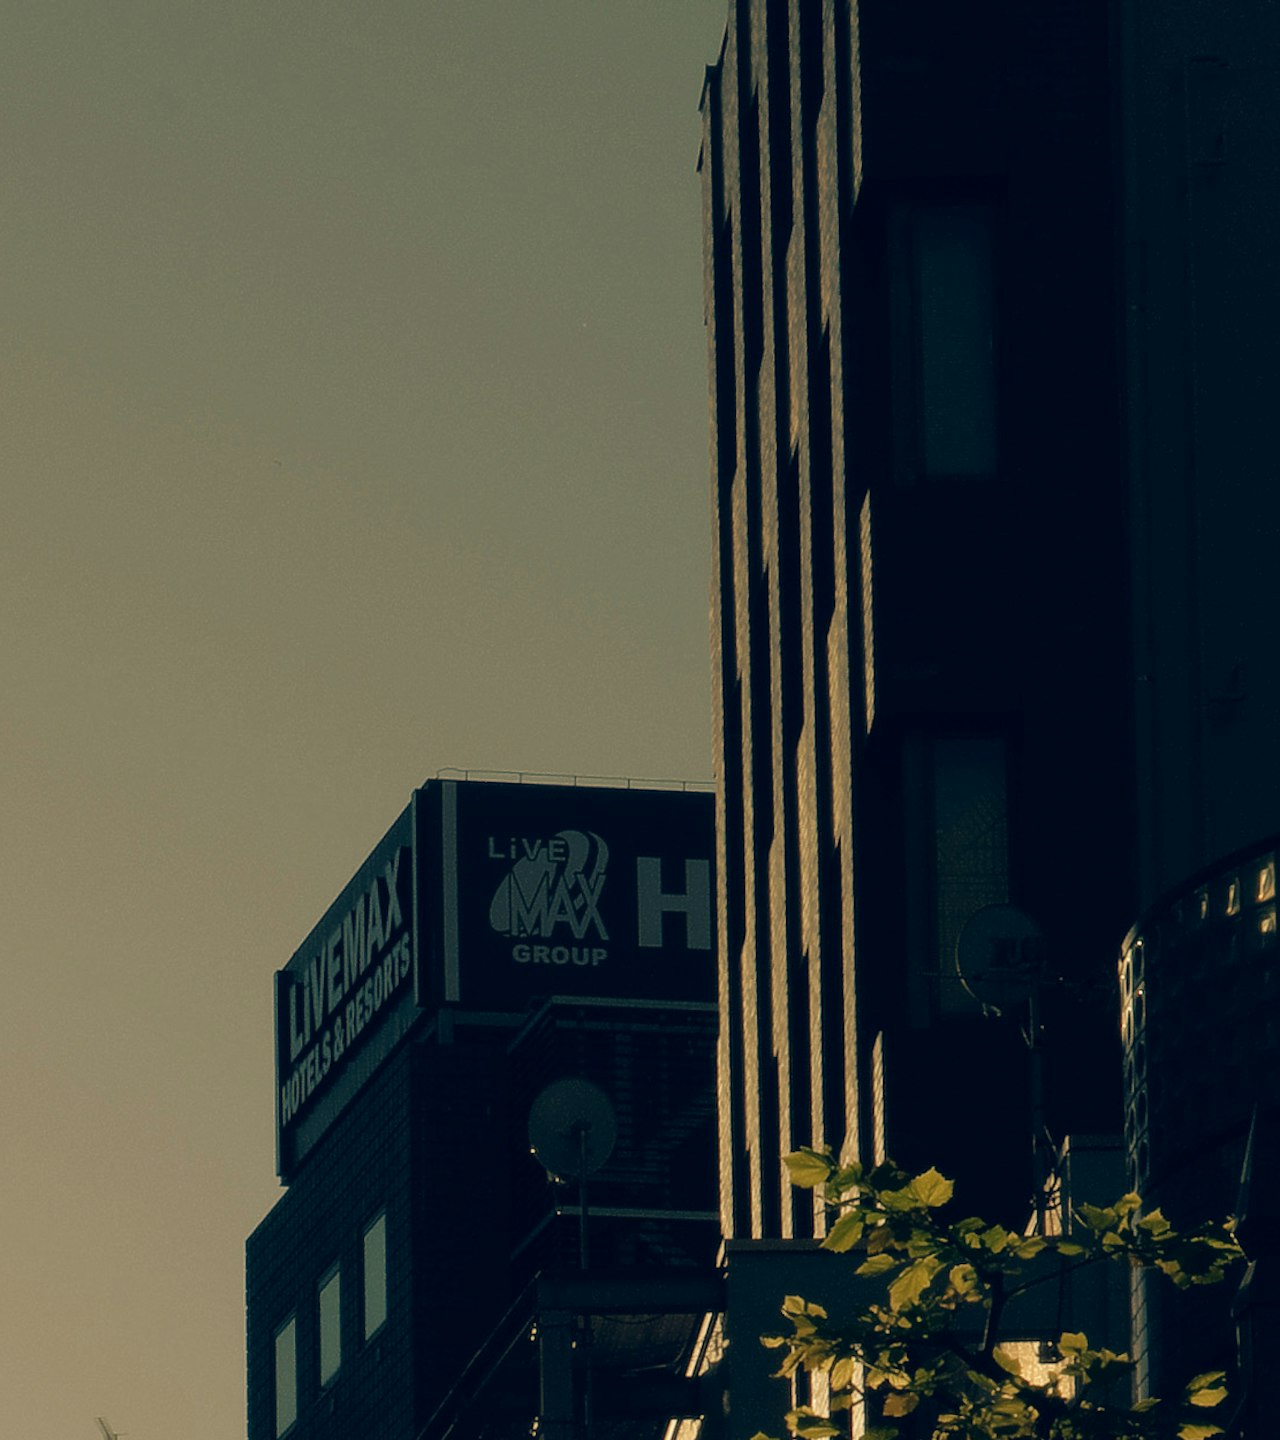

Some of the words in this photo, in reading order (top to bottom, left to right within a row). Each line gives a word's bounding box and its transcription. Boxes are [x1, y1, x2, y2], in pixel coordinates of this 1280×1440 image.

[510, 872, 610, 941] MAX
[512, 944, 609, 967] GROUP
[281, 1023, 332, 1128] HOTELS
[345, 931, 411, 1048] RESORTS
